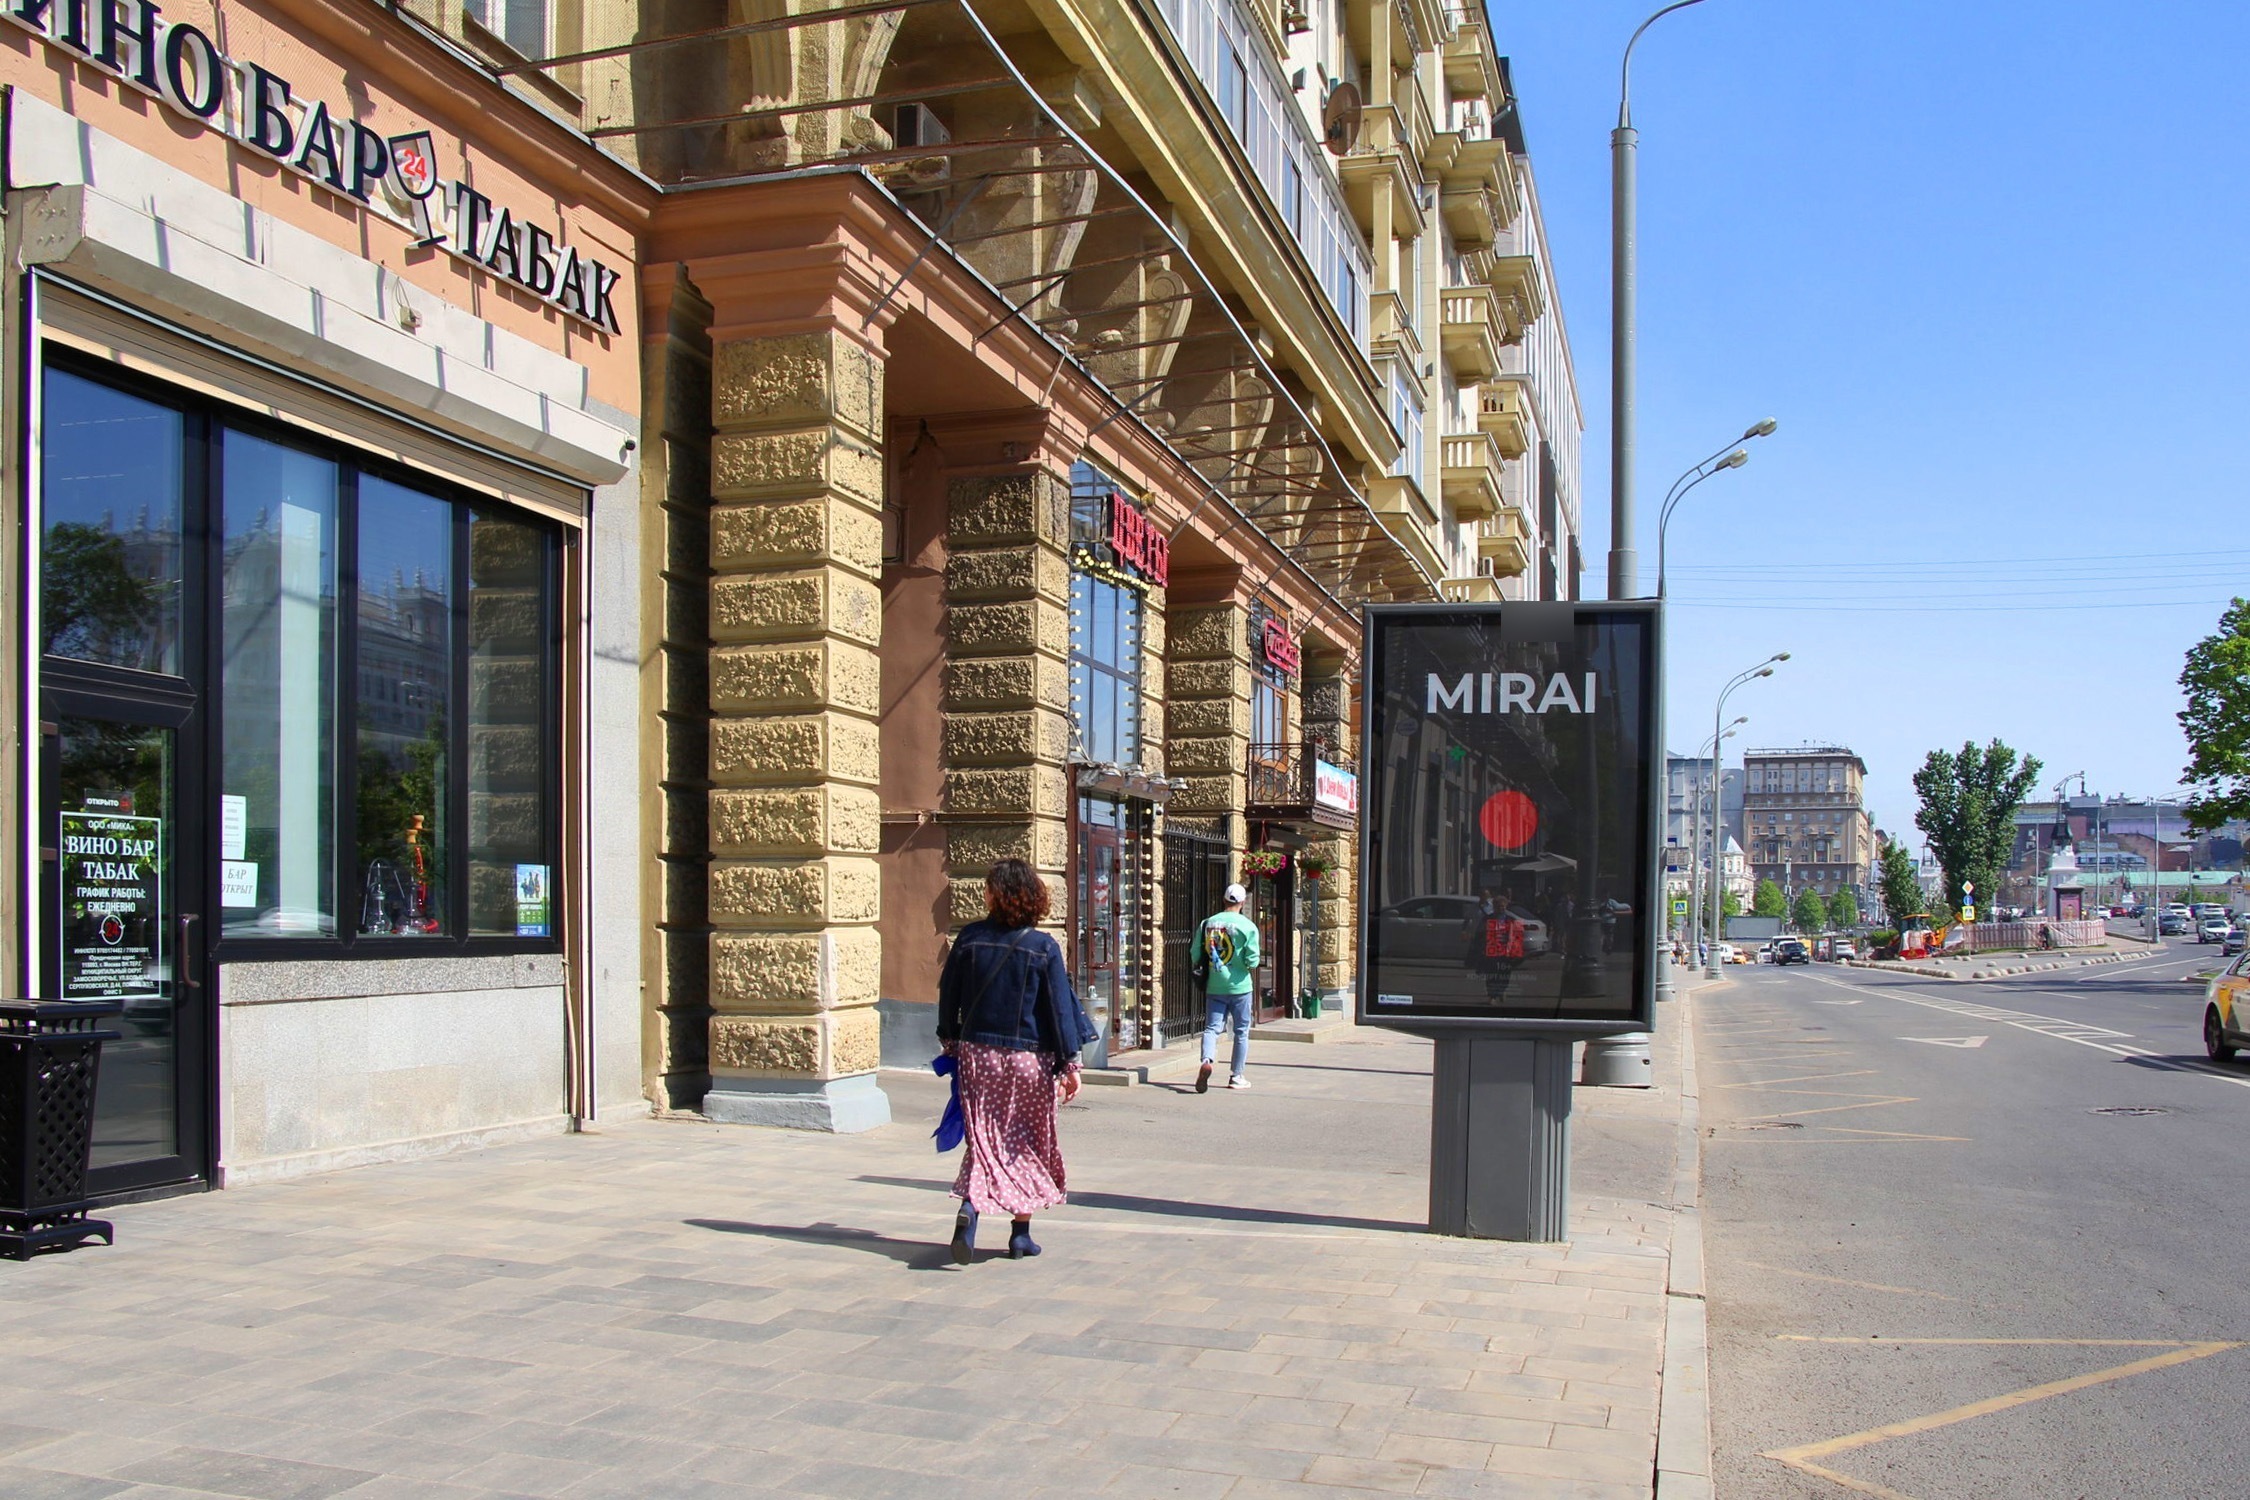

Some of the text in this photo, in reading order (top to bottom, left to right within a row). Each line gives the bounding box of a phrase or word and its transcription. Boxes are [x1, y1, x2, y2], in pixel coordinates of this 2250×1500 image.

[248, 61, 388, 203] БАР
[404, 148, 427, 181] 24
[449, 180, 623, 336] ТАБАК
[1112, 492, 1169, 588] ЦВЕТЫ
[1427, 672, 1597, 714] MIRAI
[87, 798, 119, 807] ОТКРЫТО
[88, 820, 105, 829] ООО
[67, 836, 155, 857] ВИНО БАР
[83, 861, 140, 880] ТАБАК
[228, 868, 246, 880] БАР
[77, 887, 146, 899] ГРАФИК РАБОТЫ:
[87, 902, 136, 912] ЕЖЕДНЕВНО
[105, 922, 119, 937] 24
